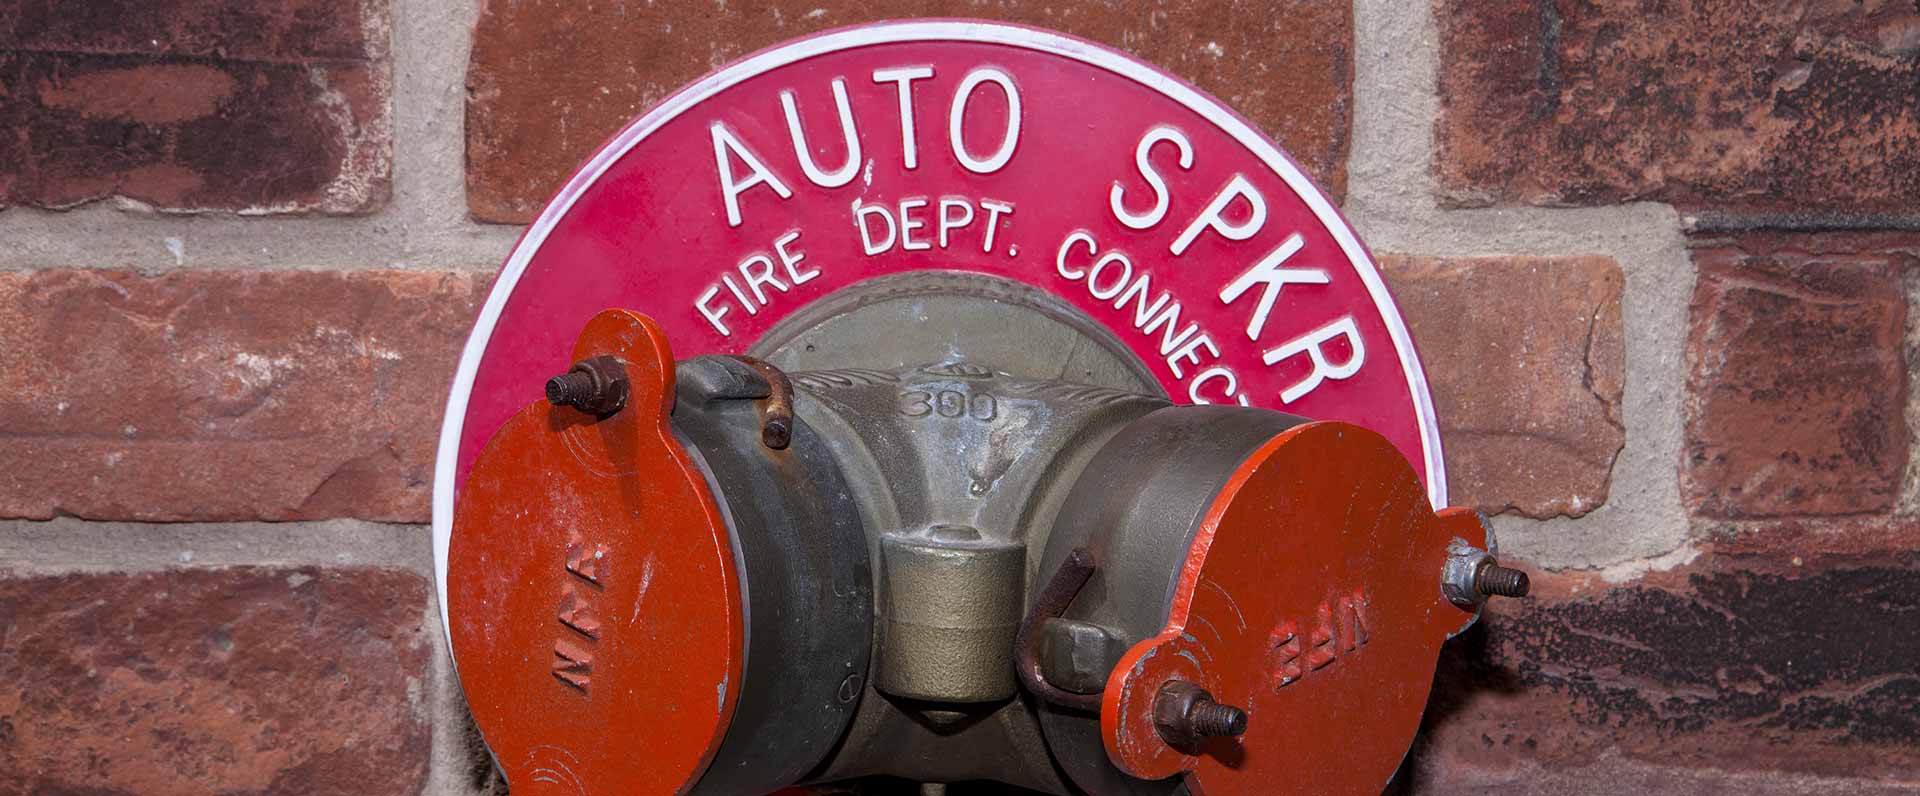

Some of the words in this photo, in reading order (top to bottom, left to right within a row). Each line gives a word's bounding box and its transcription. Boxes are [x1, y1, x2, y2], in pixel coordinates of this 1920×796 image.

[695, 230, 821, 336] FIRE
[854, 199, 1016, 256] DEPT.
[711, 66, 1021, 227] AUTO
[1110, 127, 1366, 405] SPKR
